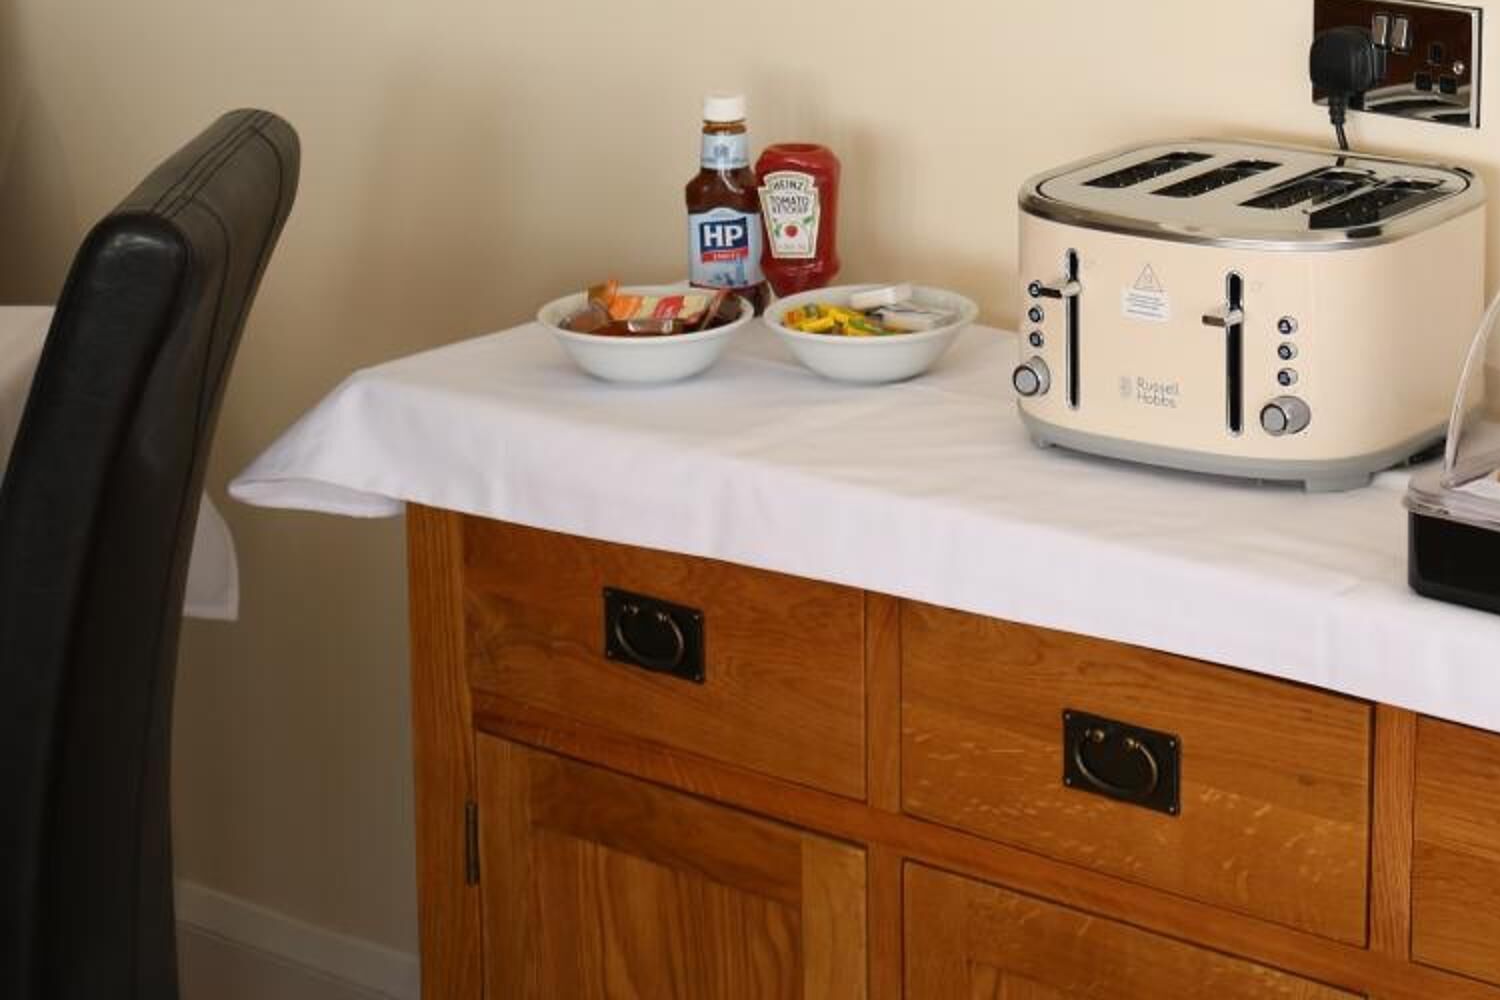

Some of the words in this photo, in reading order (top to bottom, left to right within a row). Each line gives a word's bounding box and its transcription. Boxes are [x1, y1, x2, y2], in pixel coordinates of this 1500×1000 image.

[703, 224, 743, 247] HP
[1136, 376, 1179, 396] Russell
[1136, 391, 1177, 409] Hobbs
